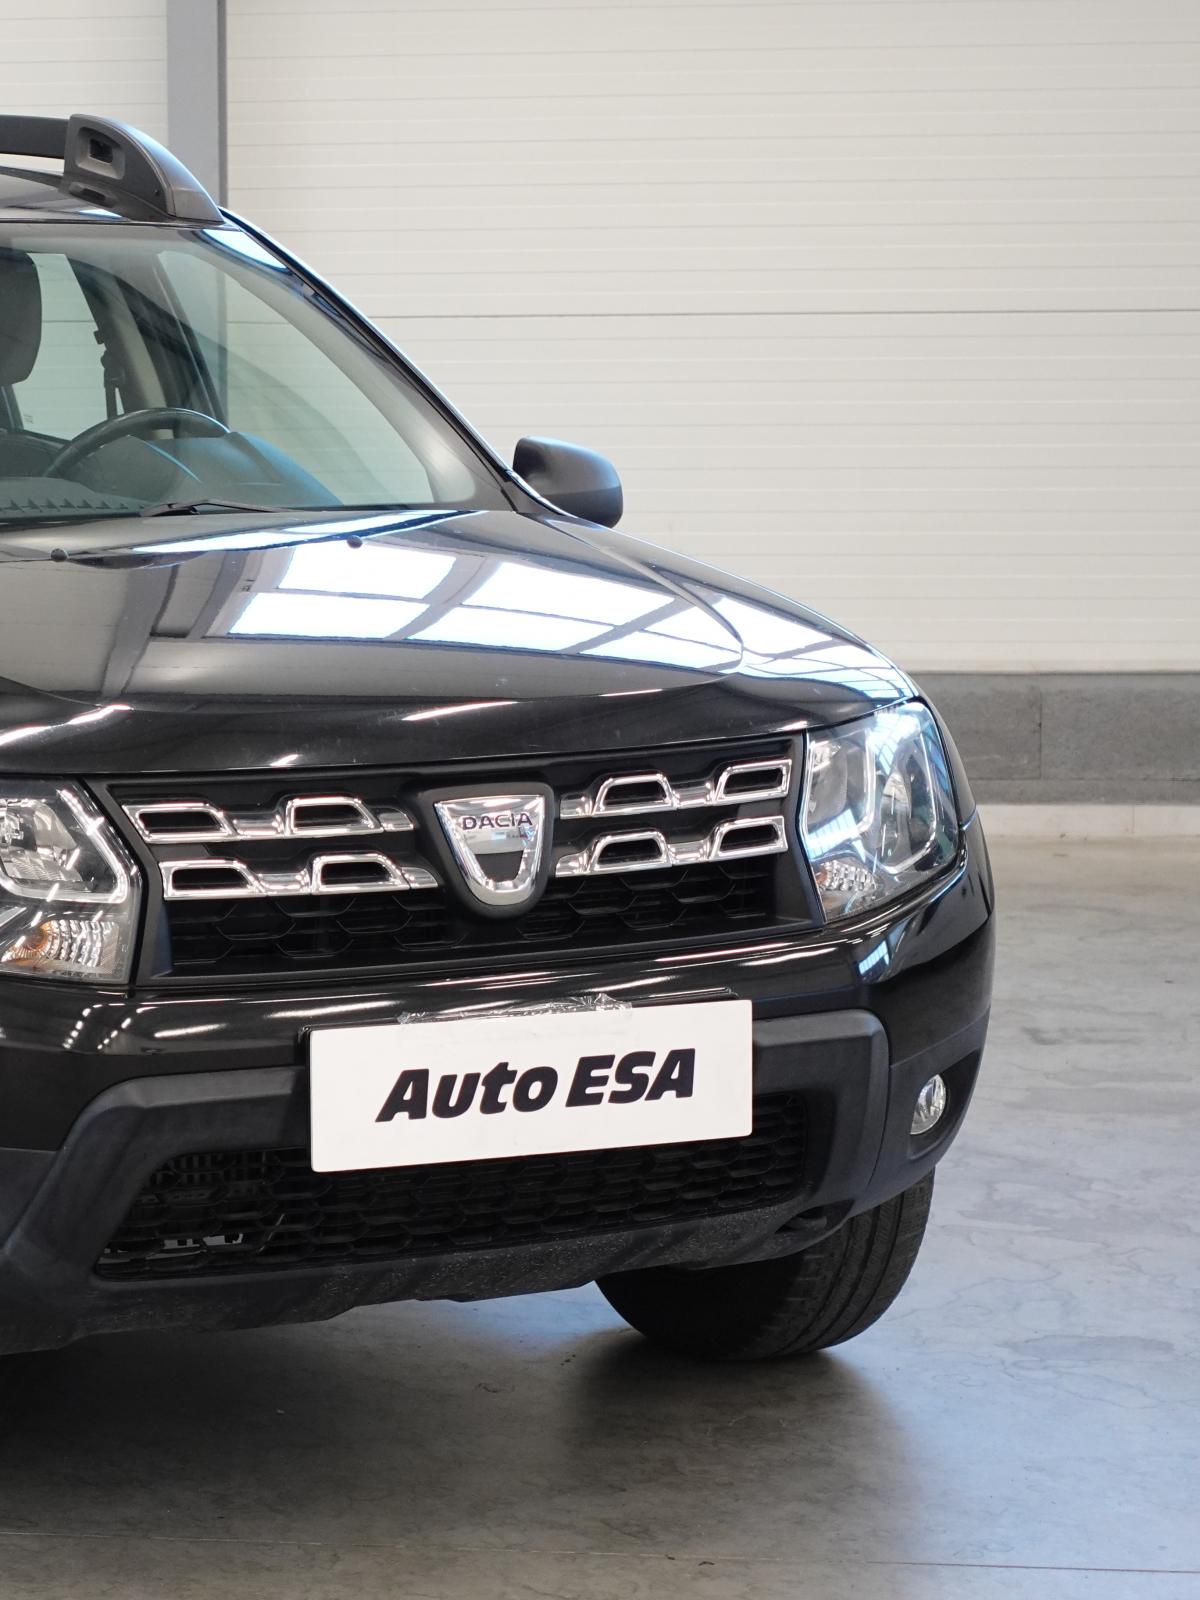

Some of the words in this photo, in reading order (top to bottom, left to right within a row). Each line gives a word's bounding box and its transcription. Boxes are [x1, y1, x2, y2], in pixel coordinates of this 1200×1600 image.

[461, 813, 533, 830] DACIA
[375, 1062, 559, 1123] Auto
[565, 1047, 696, 1108] ESA
